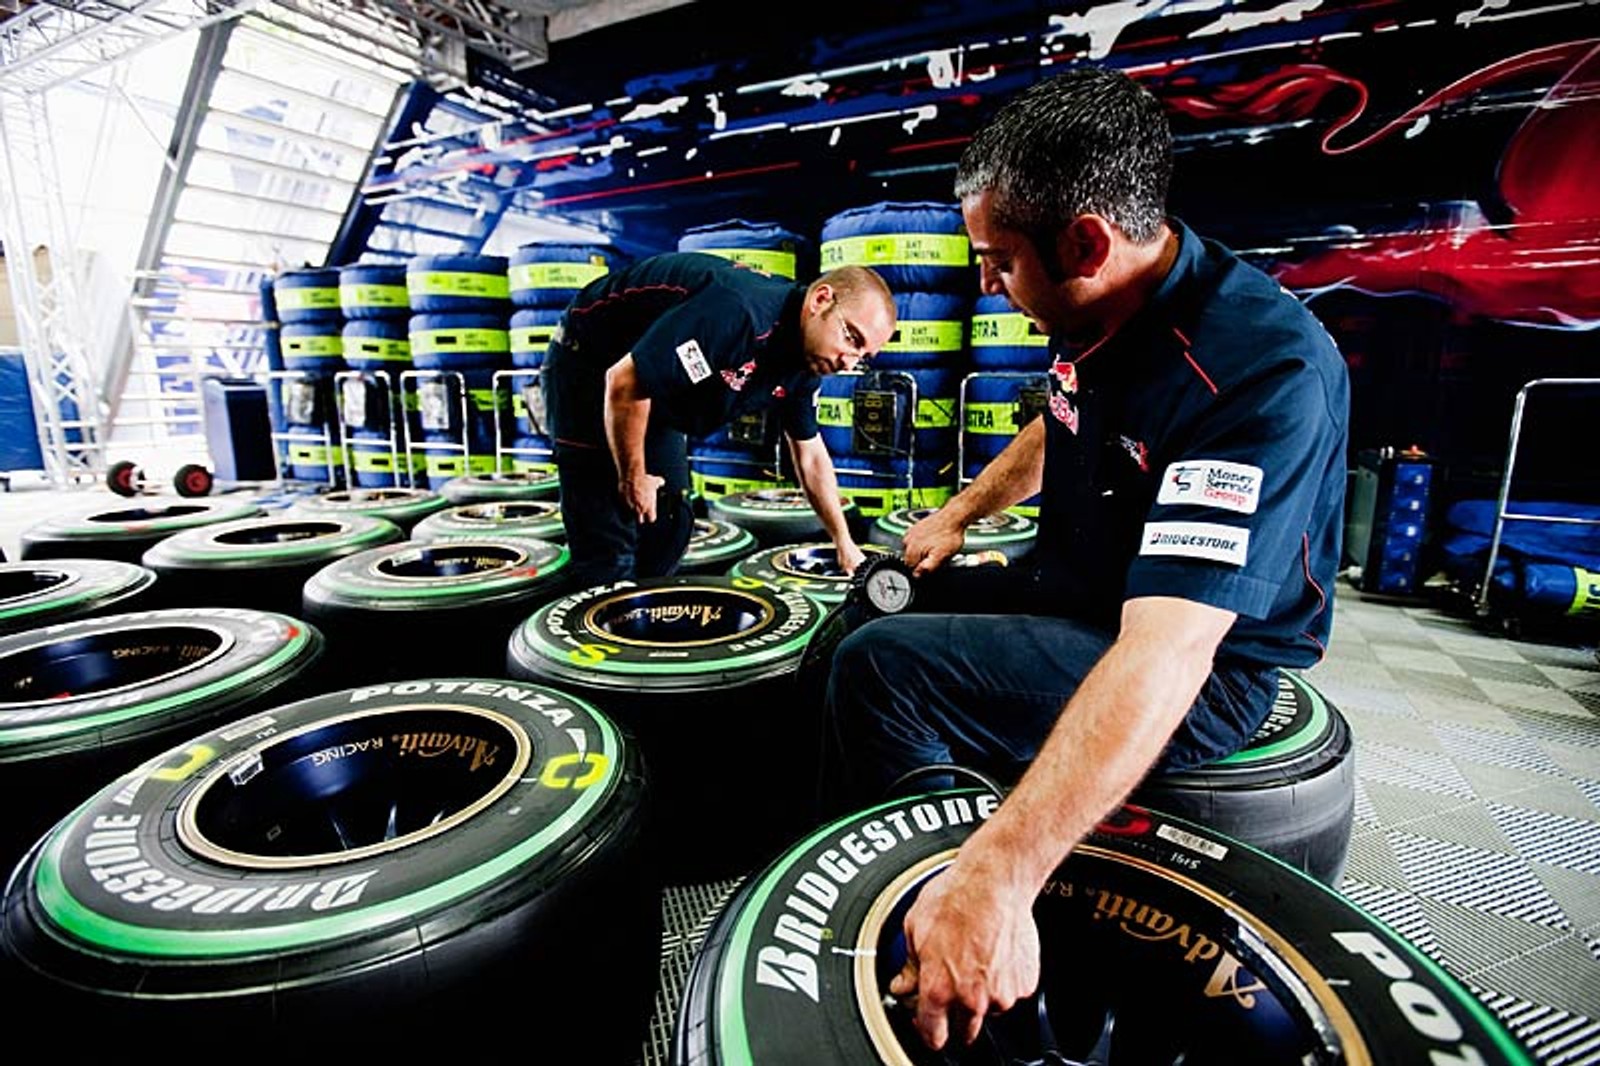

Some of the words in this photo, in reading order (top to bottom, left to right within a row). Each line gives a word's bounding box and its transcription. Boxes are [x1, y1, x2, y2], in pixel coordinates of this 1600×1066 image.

[1205, 478, 1254, 495] Service
[1207, 467, 1255, 484] Money
[1204, 488, 1247, 506] Group
[1150, 531, 1239, 551] BRIDGESTONE
[350, 681, 576, 728] POTENZA
[312, 736, 384, 767] RACING
[399, 731, 500, 772] Advanti
[84, 813, 380, 914] BRIDGESTONE
[756, 793, 1000, 1003] BRIDGESTONE
[1095, 888, 1268, 1010] Advanti
